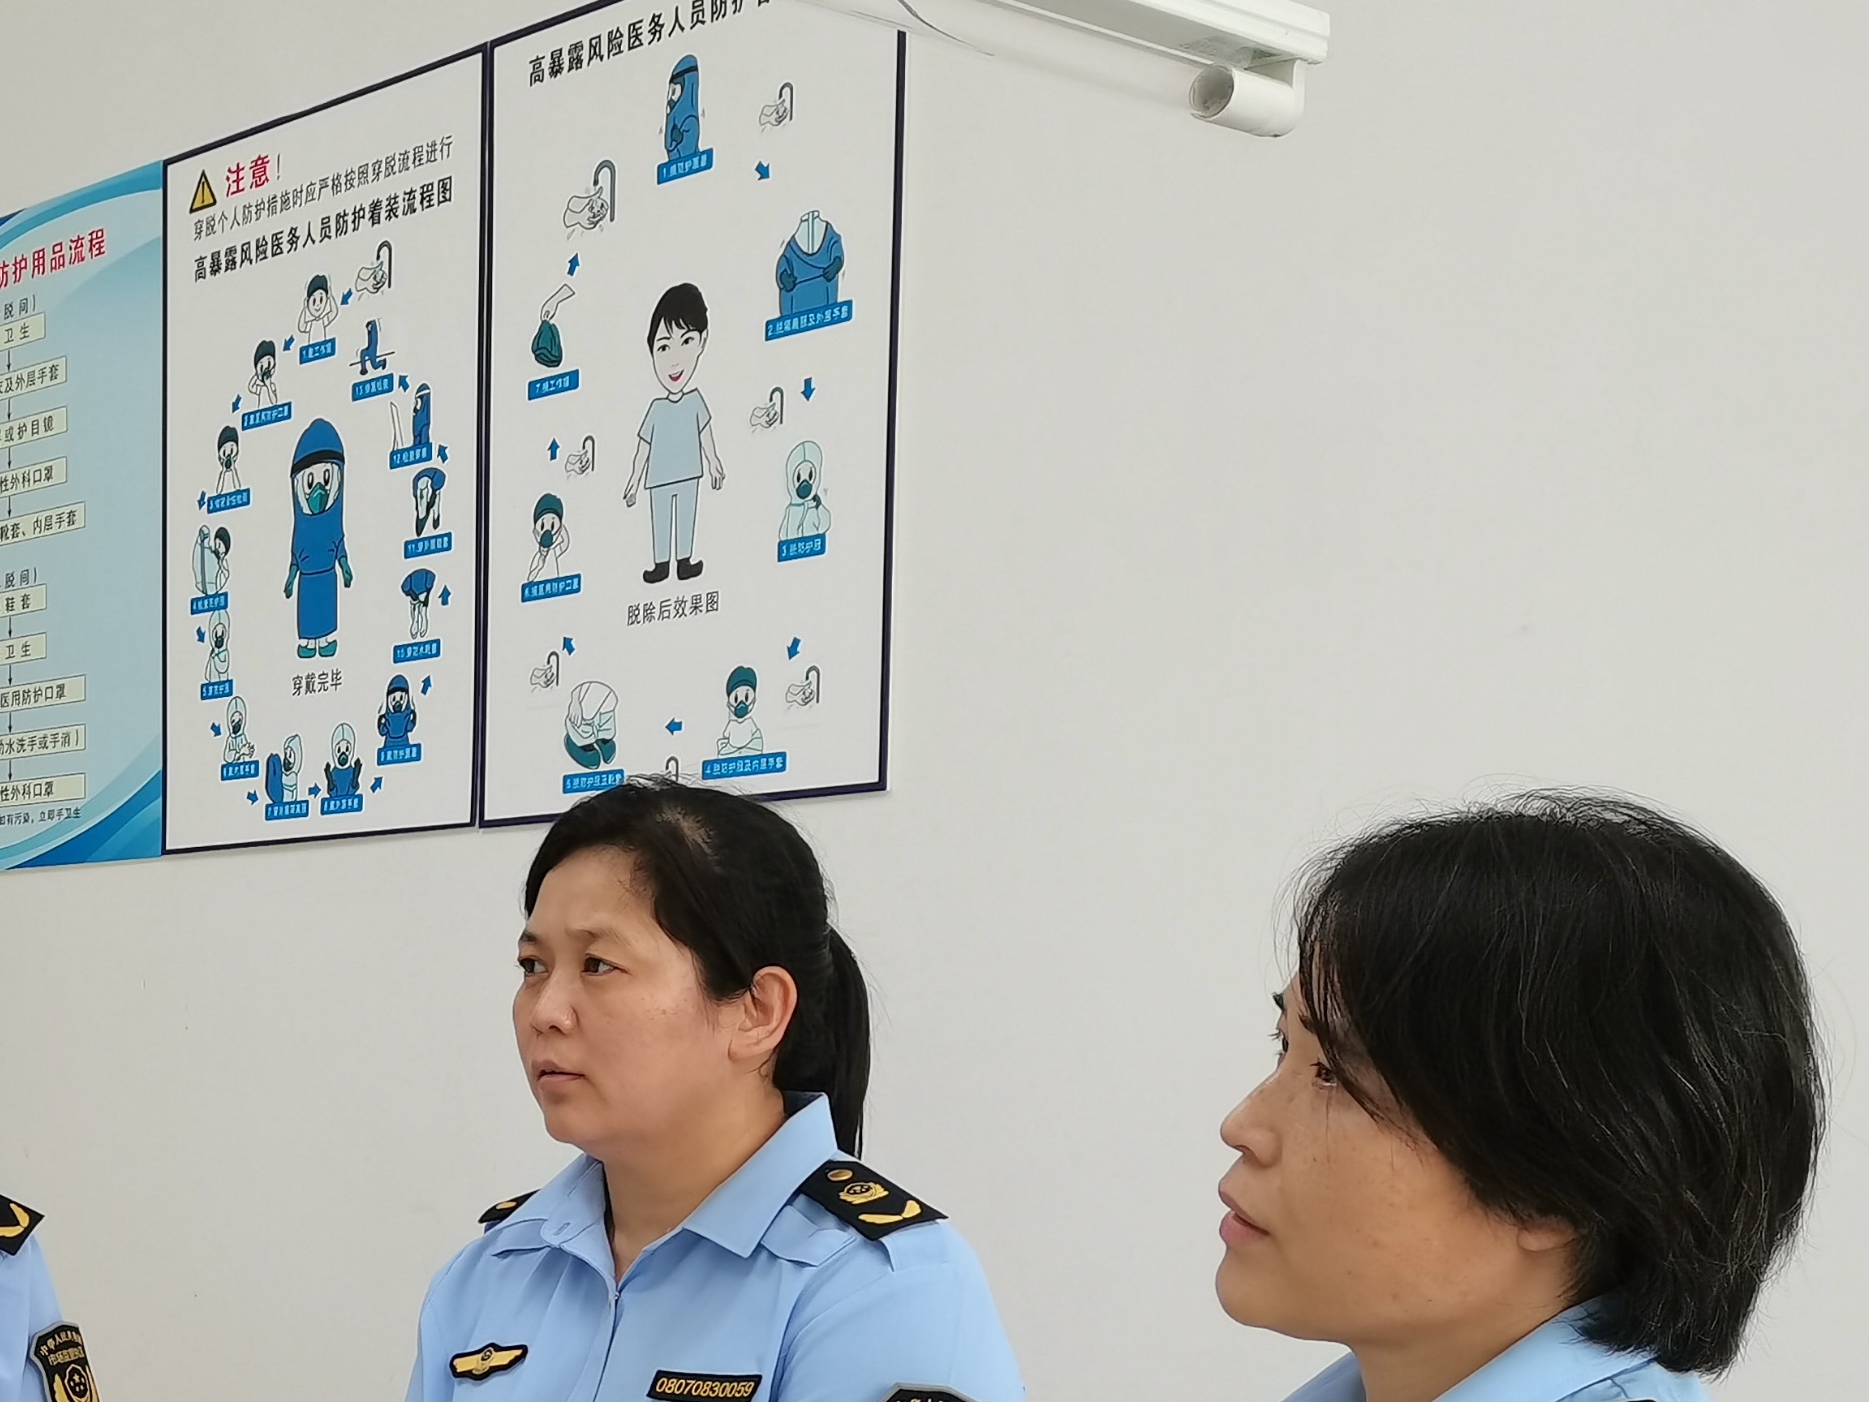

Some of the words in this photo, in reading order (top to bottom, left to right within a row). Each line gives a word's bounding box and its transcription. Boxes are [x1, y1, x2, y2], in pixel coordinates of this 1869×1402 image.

[529, 0, 770, 87] 高暴露风险医务人员防
[194, 176, 453, 282] 高暴露风险医务人员防护着装流程图
[627, 591, 720, 626] 脱除后效果图
[292, 669, 343, 696] 穿戴完毕
[656, 1378, 755, 1397] 08070830059
